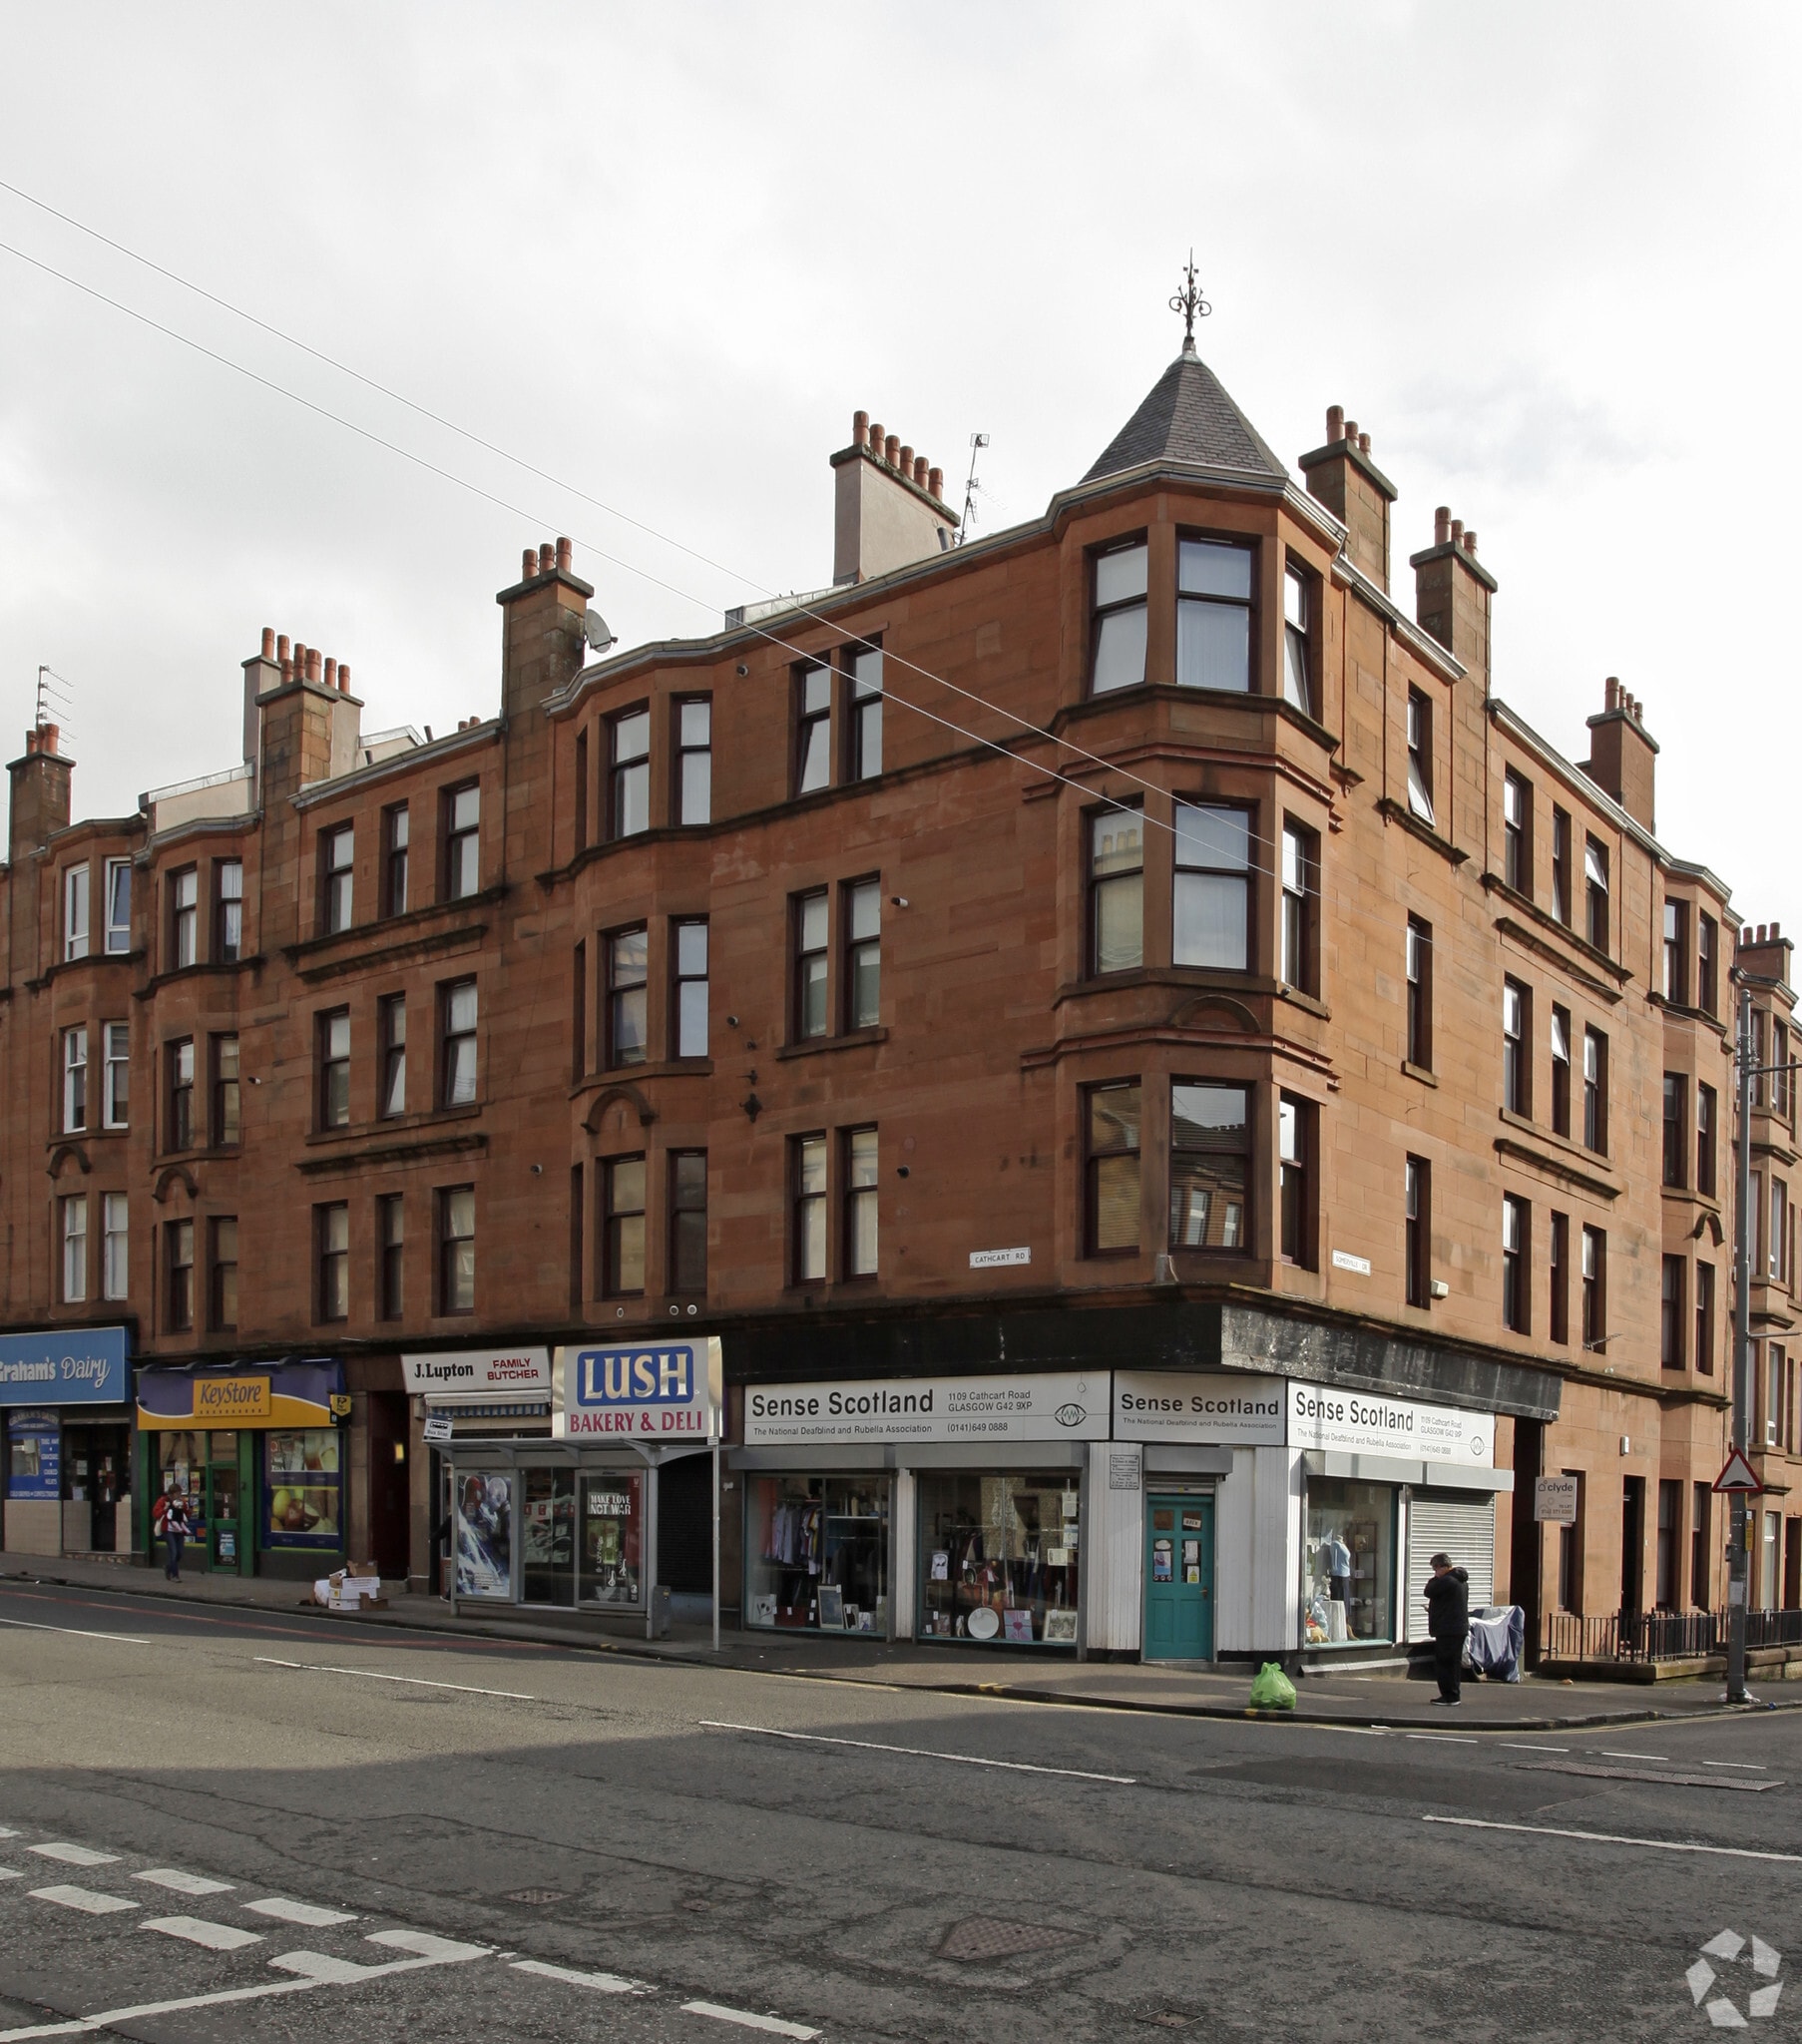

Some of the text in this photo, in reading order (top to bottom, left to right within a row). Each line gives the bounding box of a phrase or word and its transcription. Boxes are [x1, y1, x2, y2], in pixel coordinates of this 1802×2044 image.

[975, 1254, 1010, 1263] CATHCART
[492, 1358, 531, 1368] FAMILY
[61, 1356, 111, 1388] Dairy
[487, 1369, 539, 1380] BUTCHER
[584, 1353, 688, 1400] LUSH
[201, 1381, 261, 1407] KeyStore
[949, 1390, 1031, 1401] 1109 Cathcart Road
[752, 1388, 933, 1416] Sense Scotland
[948, 1401, 1033, 1412] GLASGOW G42 9XP
[1122, 1394, 1279, 1415] Sense Scotland
[1296, 1391, 1413, 1432] Sense Scotland
[570, 1411, 702, 1432] BAKERY & DELI
[947, 1422, 1008, 1432] (0141)649 0888
[1432, 1417, 1450, 1427] Cathcart
[800, 1426, 835, 1435] Deafblind
[885, 1424, 932, 1433] Association
[1421, 1426, 1444, 1435] GLASGOW
[1297, 1428, 1307, 1437] The
[1308, 1429, 1330, 1440] National
[1331, 1432, 1354, 1443] Deafblind
[1367, 1437, 1384, 1447] Rubella
[1385, 1440, 1412, 1450] Association
[1548, 1483, 1574, 1493] clyde
[591, 1495, 631, 1504] MAKE LOVE
[591, 1504, 631, 1515] NOT WAR
